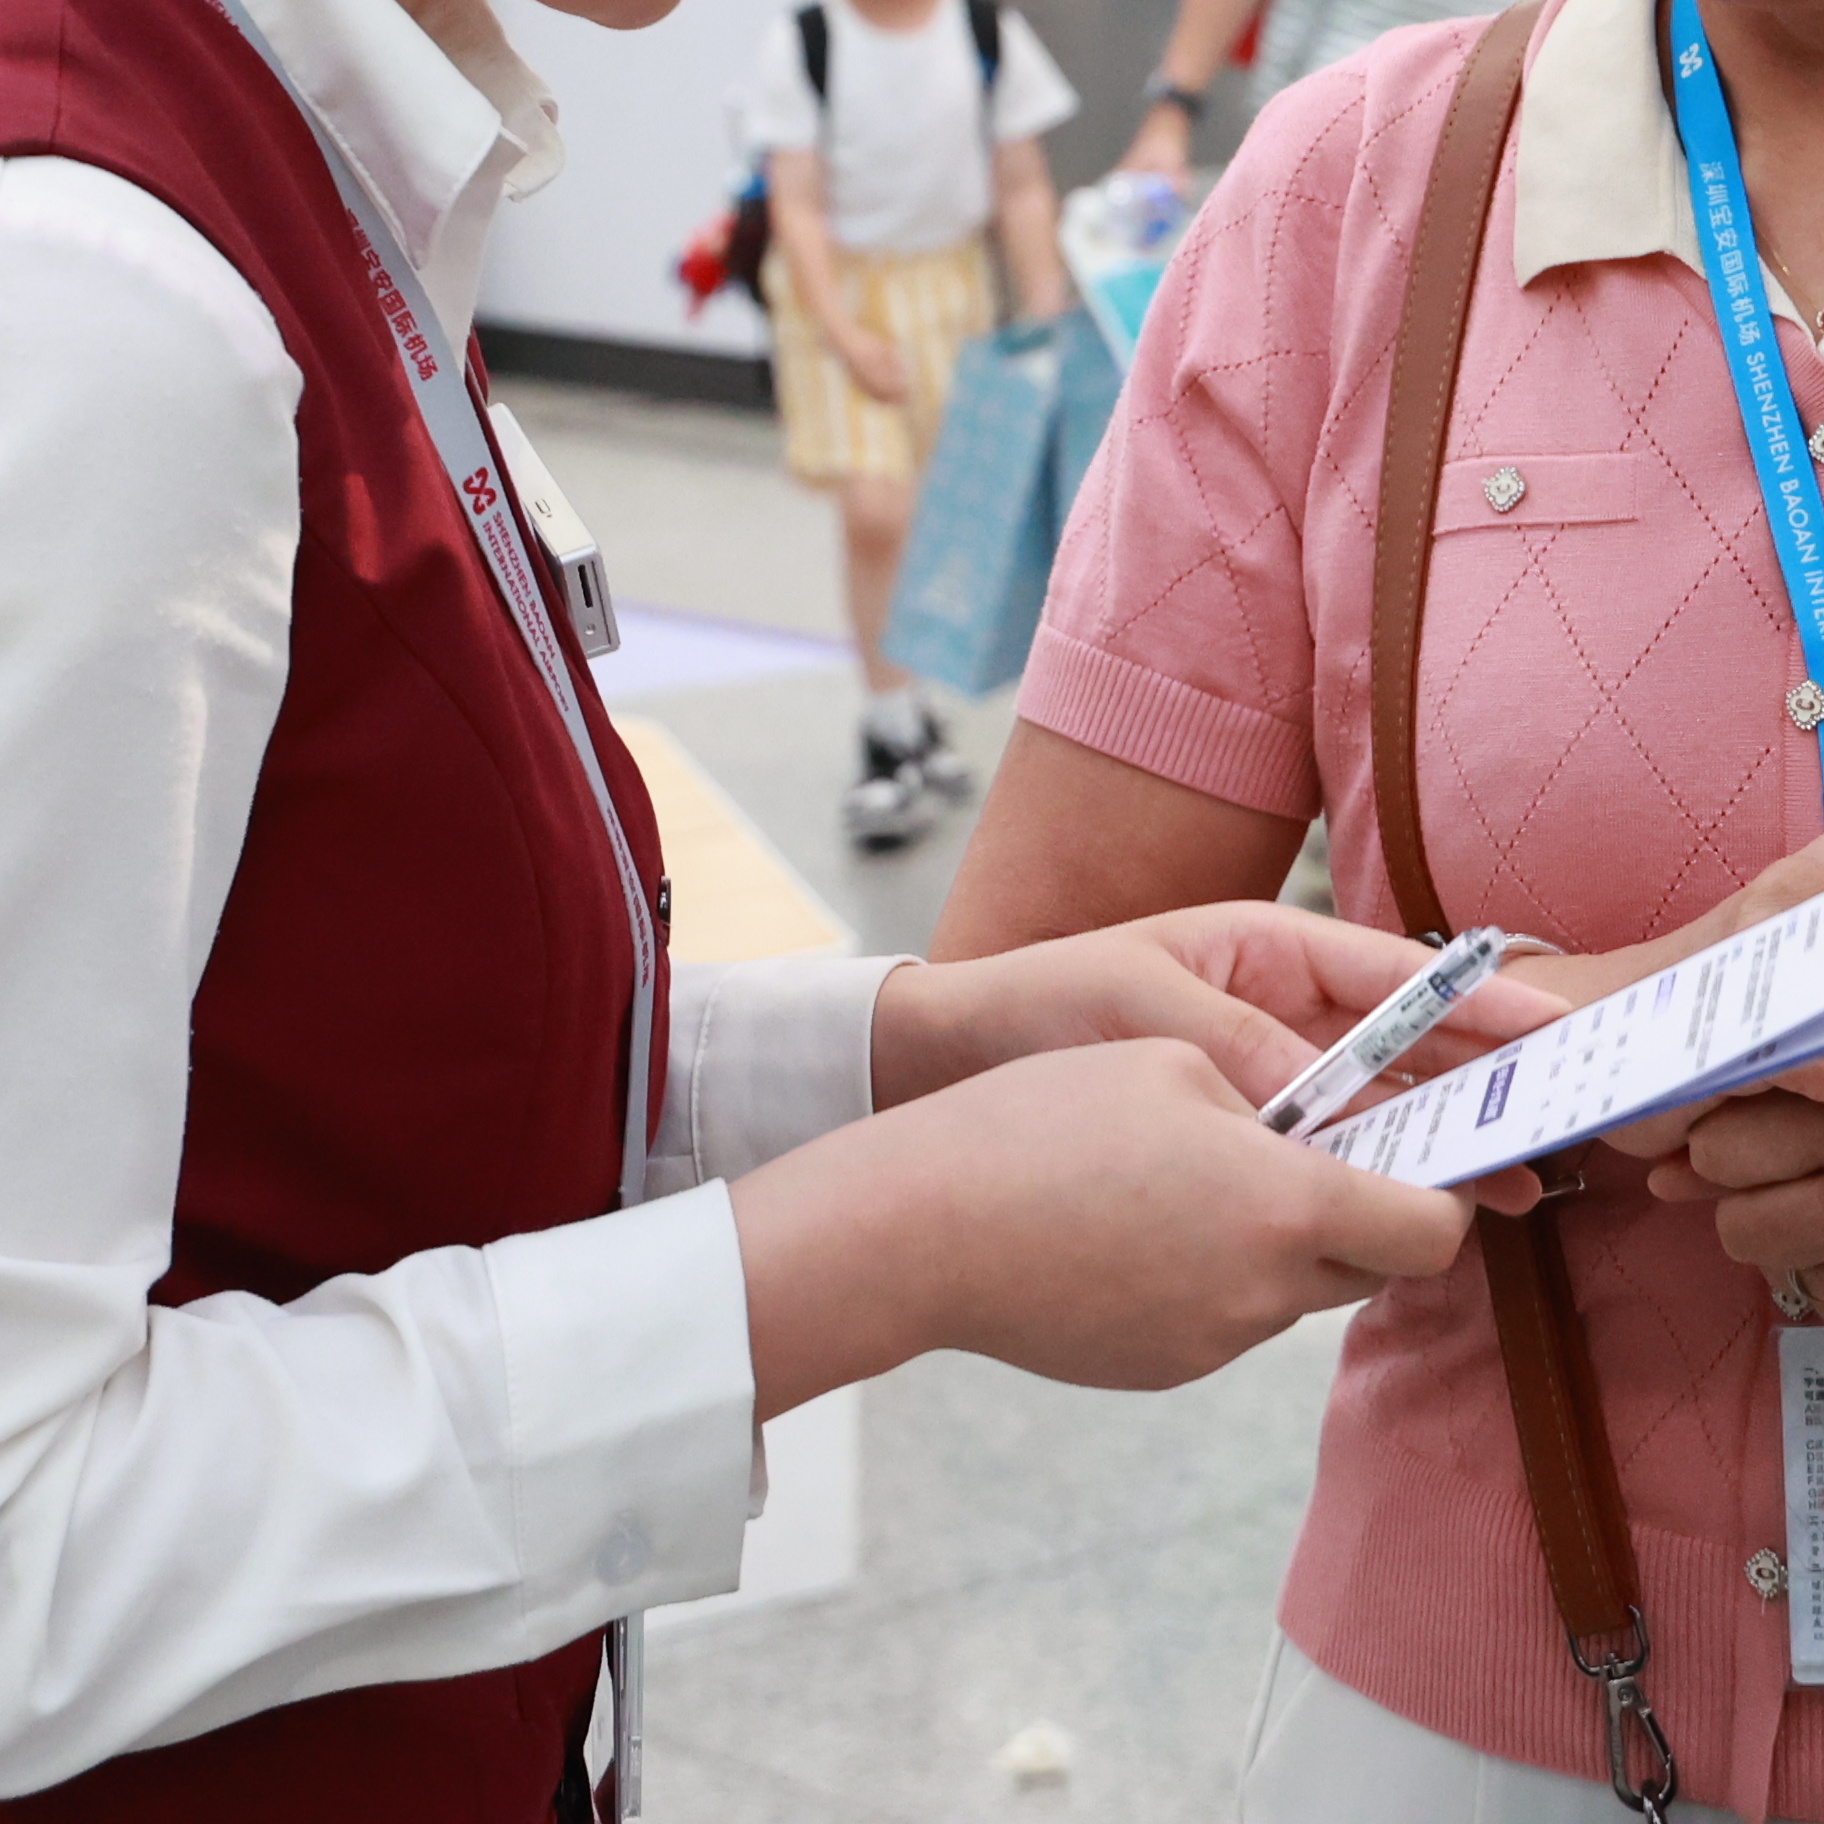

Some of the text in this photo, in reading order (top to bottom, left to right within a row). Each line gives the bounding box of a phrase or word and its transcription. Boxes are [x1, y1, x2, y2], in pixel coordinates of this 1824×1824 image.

[1699, 161, 1761, 347] 深圳宝安国际机场
[1746, 351, 1794, 474] SHENZHEN
[1779, 478, 1820, 564] BAOAN
[482, 521, 540, 648] INTERNATIONAL
[492, 510, 556, 659] SHENZHEN BAOAN
